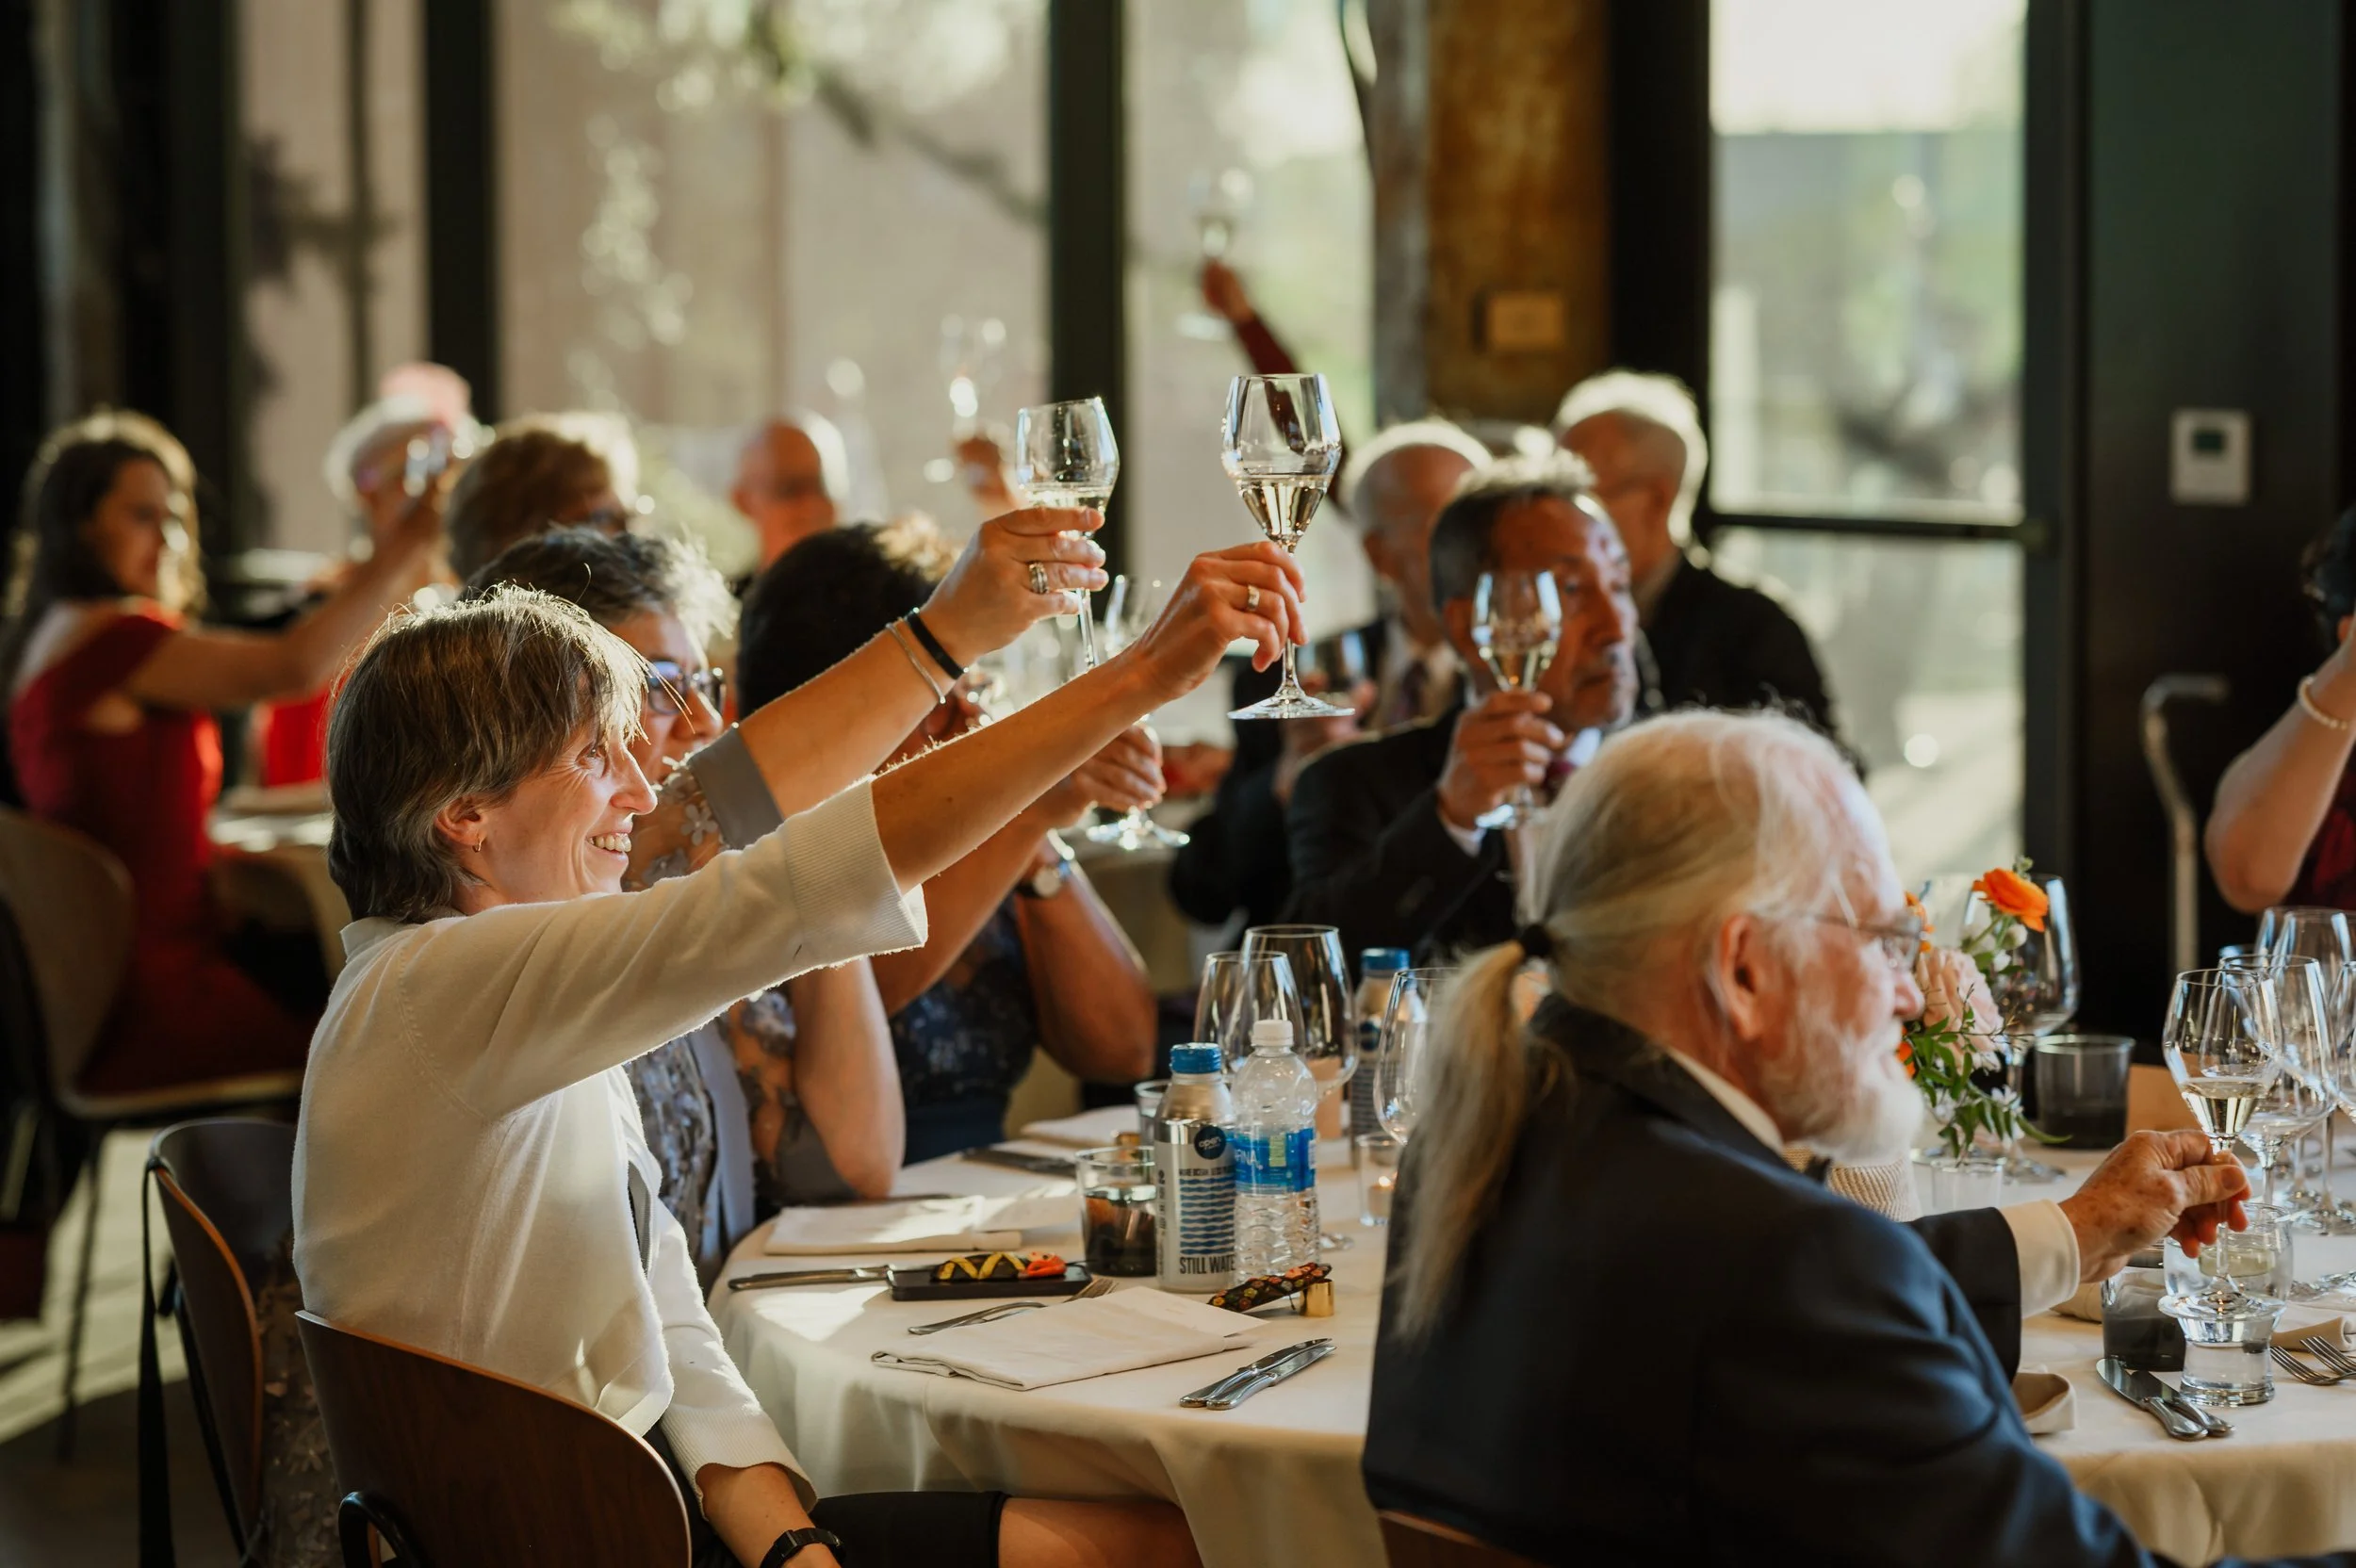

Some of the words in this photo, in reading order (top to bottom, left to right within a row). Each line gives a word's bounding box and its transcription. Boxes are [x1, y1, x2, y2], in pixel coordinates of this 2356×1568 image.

[1199, 1136, 1221, 1150] open
[1235, 1149, 1259, 1168] FINA
[1180, 1256, 1206, 1274] STILL
[1209, 1254, 1235, 1273] WATE
